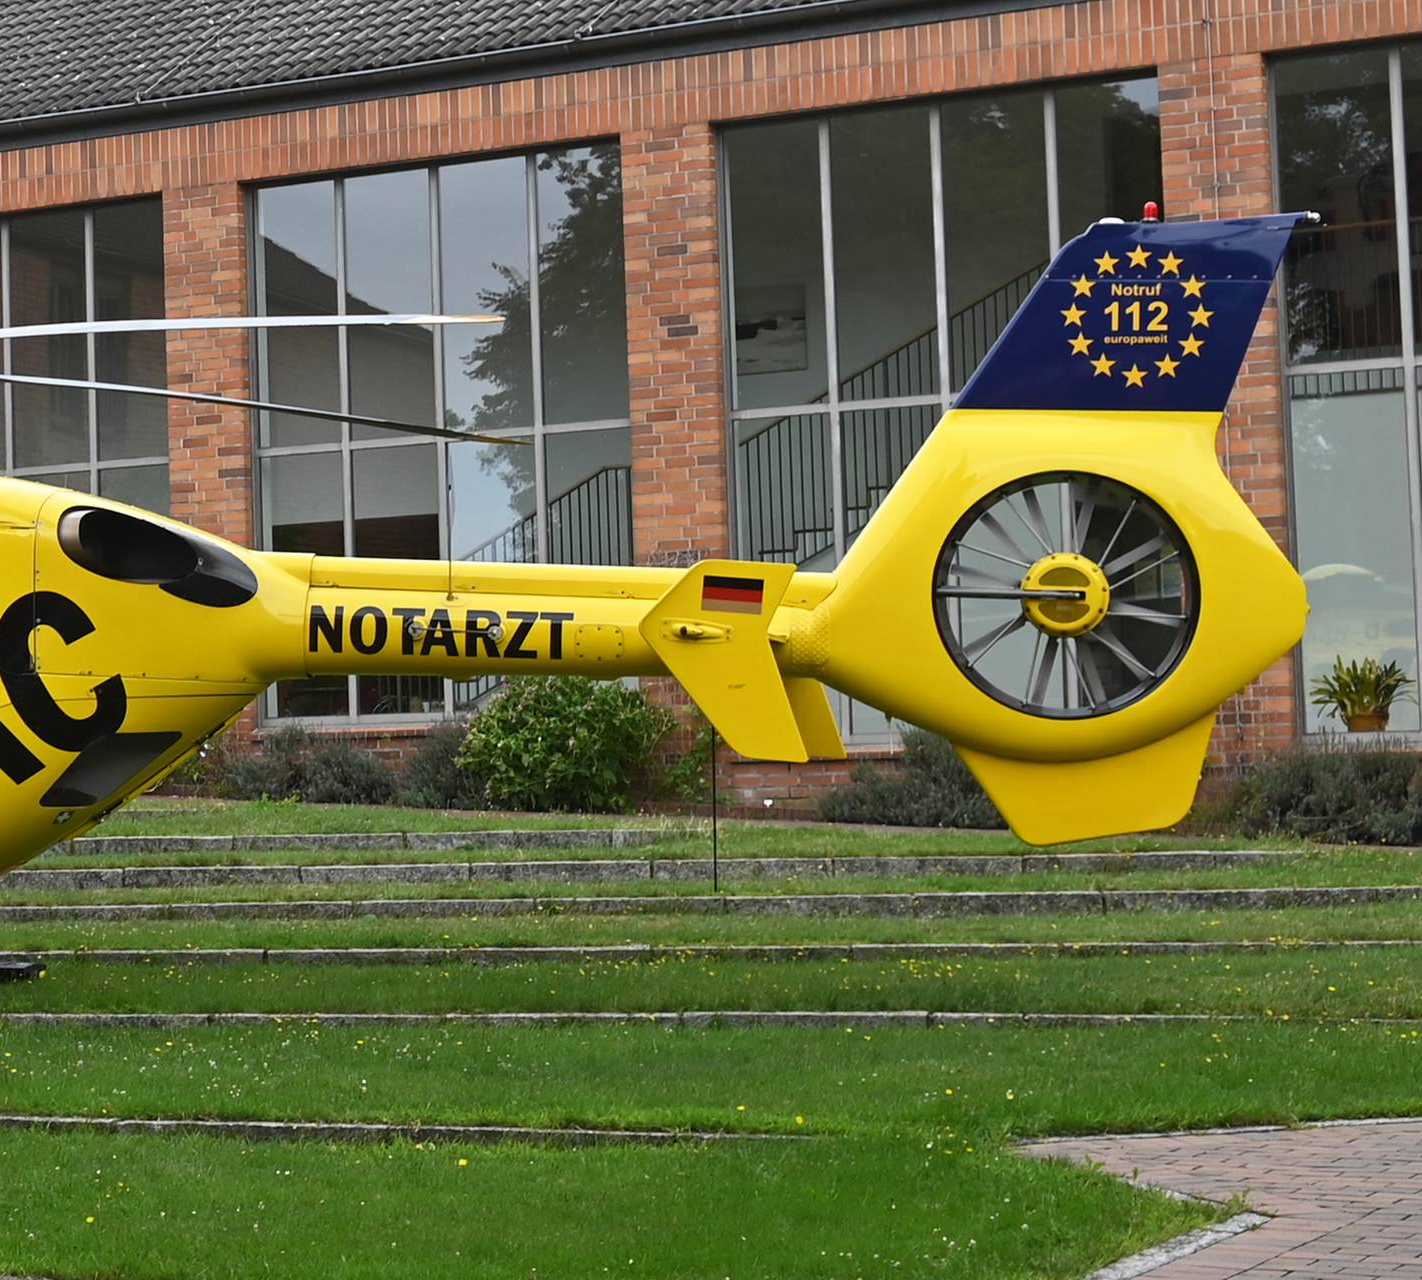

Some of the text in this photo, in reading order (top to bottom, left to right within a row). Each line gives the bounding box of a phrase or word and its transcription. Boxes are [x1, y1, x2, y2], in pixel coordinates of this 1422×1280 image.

[1111, 283, 1162, 296] Notruf
[1104, 301, 1169, 331] 112
[1104, 334, 1168, 346] europaweit
[309, 604, 574, 660] NOTARZT
